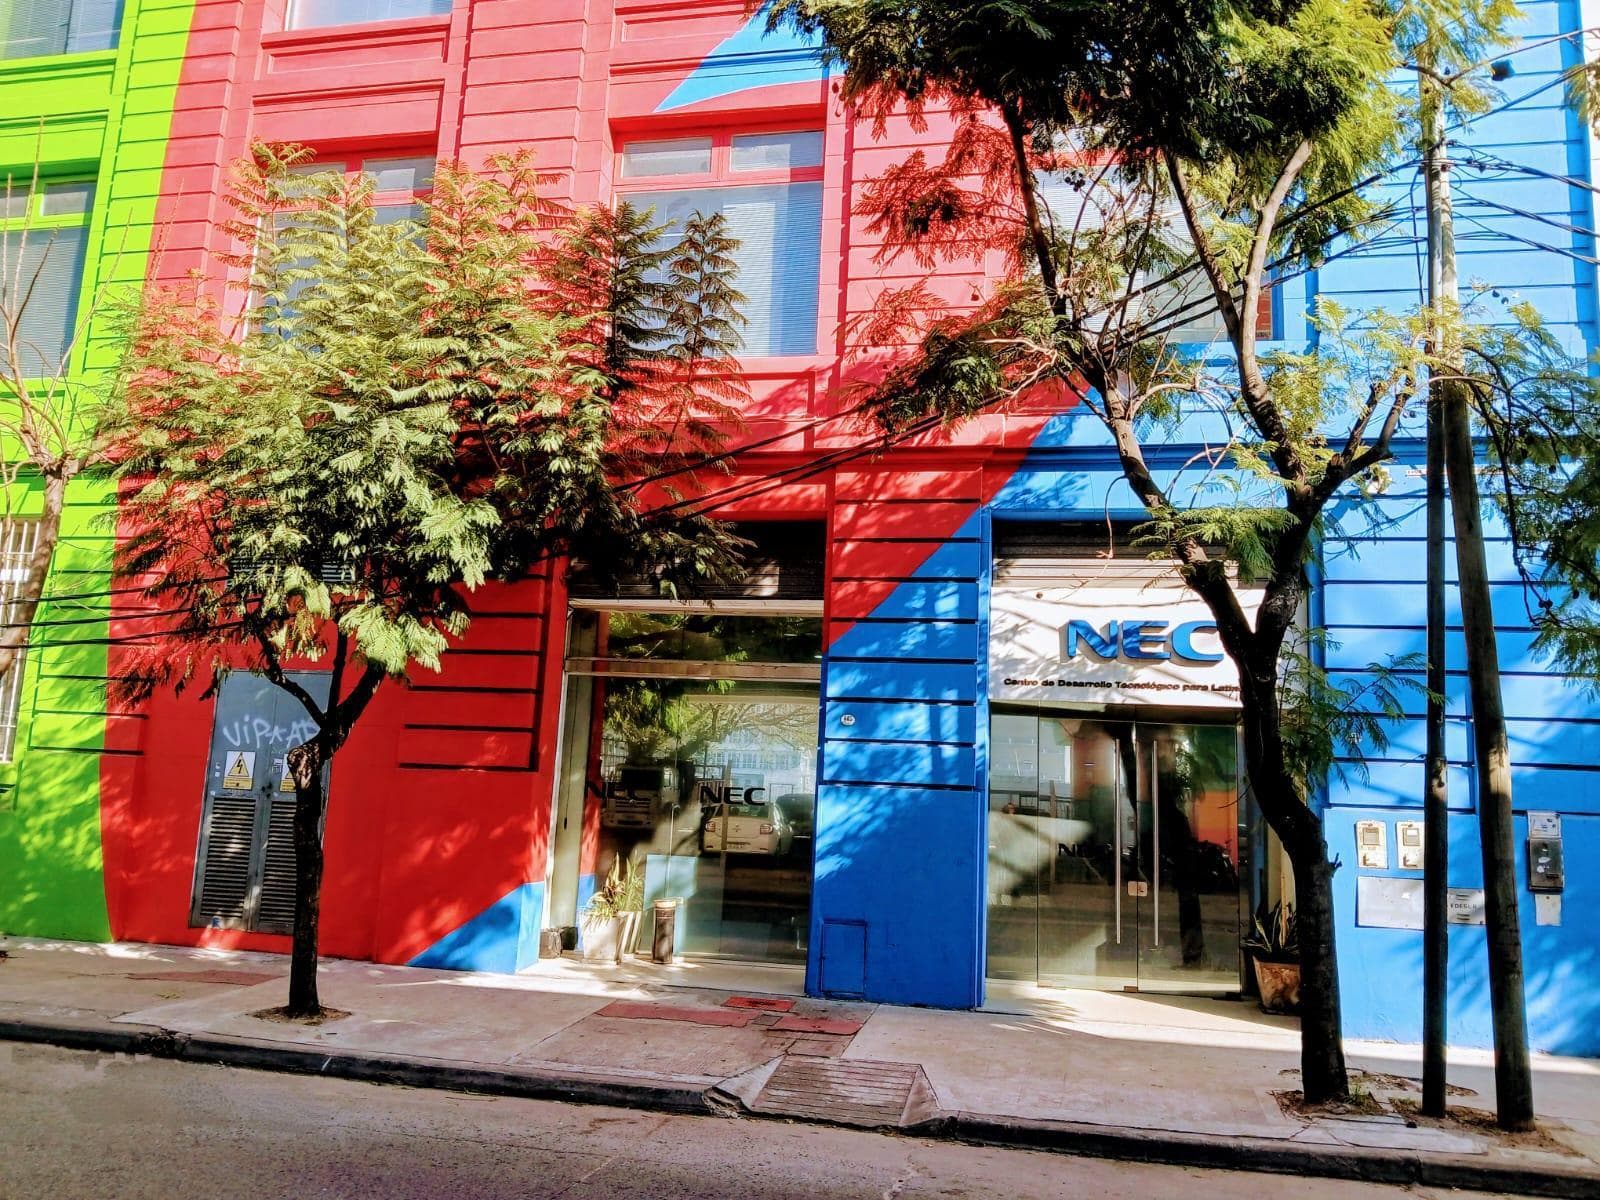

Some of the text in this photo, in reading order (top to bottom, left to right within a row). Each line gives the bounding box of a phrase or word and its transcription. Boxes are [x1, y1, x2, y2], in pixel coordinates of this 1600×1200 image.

[1067, 618, 1224, 662] NEC
[1003, 678, 1038, 686] Centro
[1041, 679, 1055, 687] de
[1057, 679, 1112, 689] Desarrollo
[1115, 681, 1180, 691] Tecnológico
[1182, 684, 1209, 692] para
[700, 785, 766, 805] NEC
